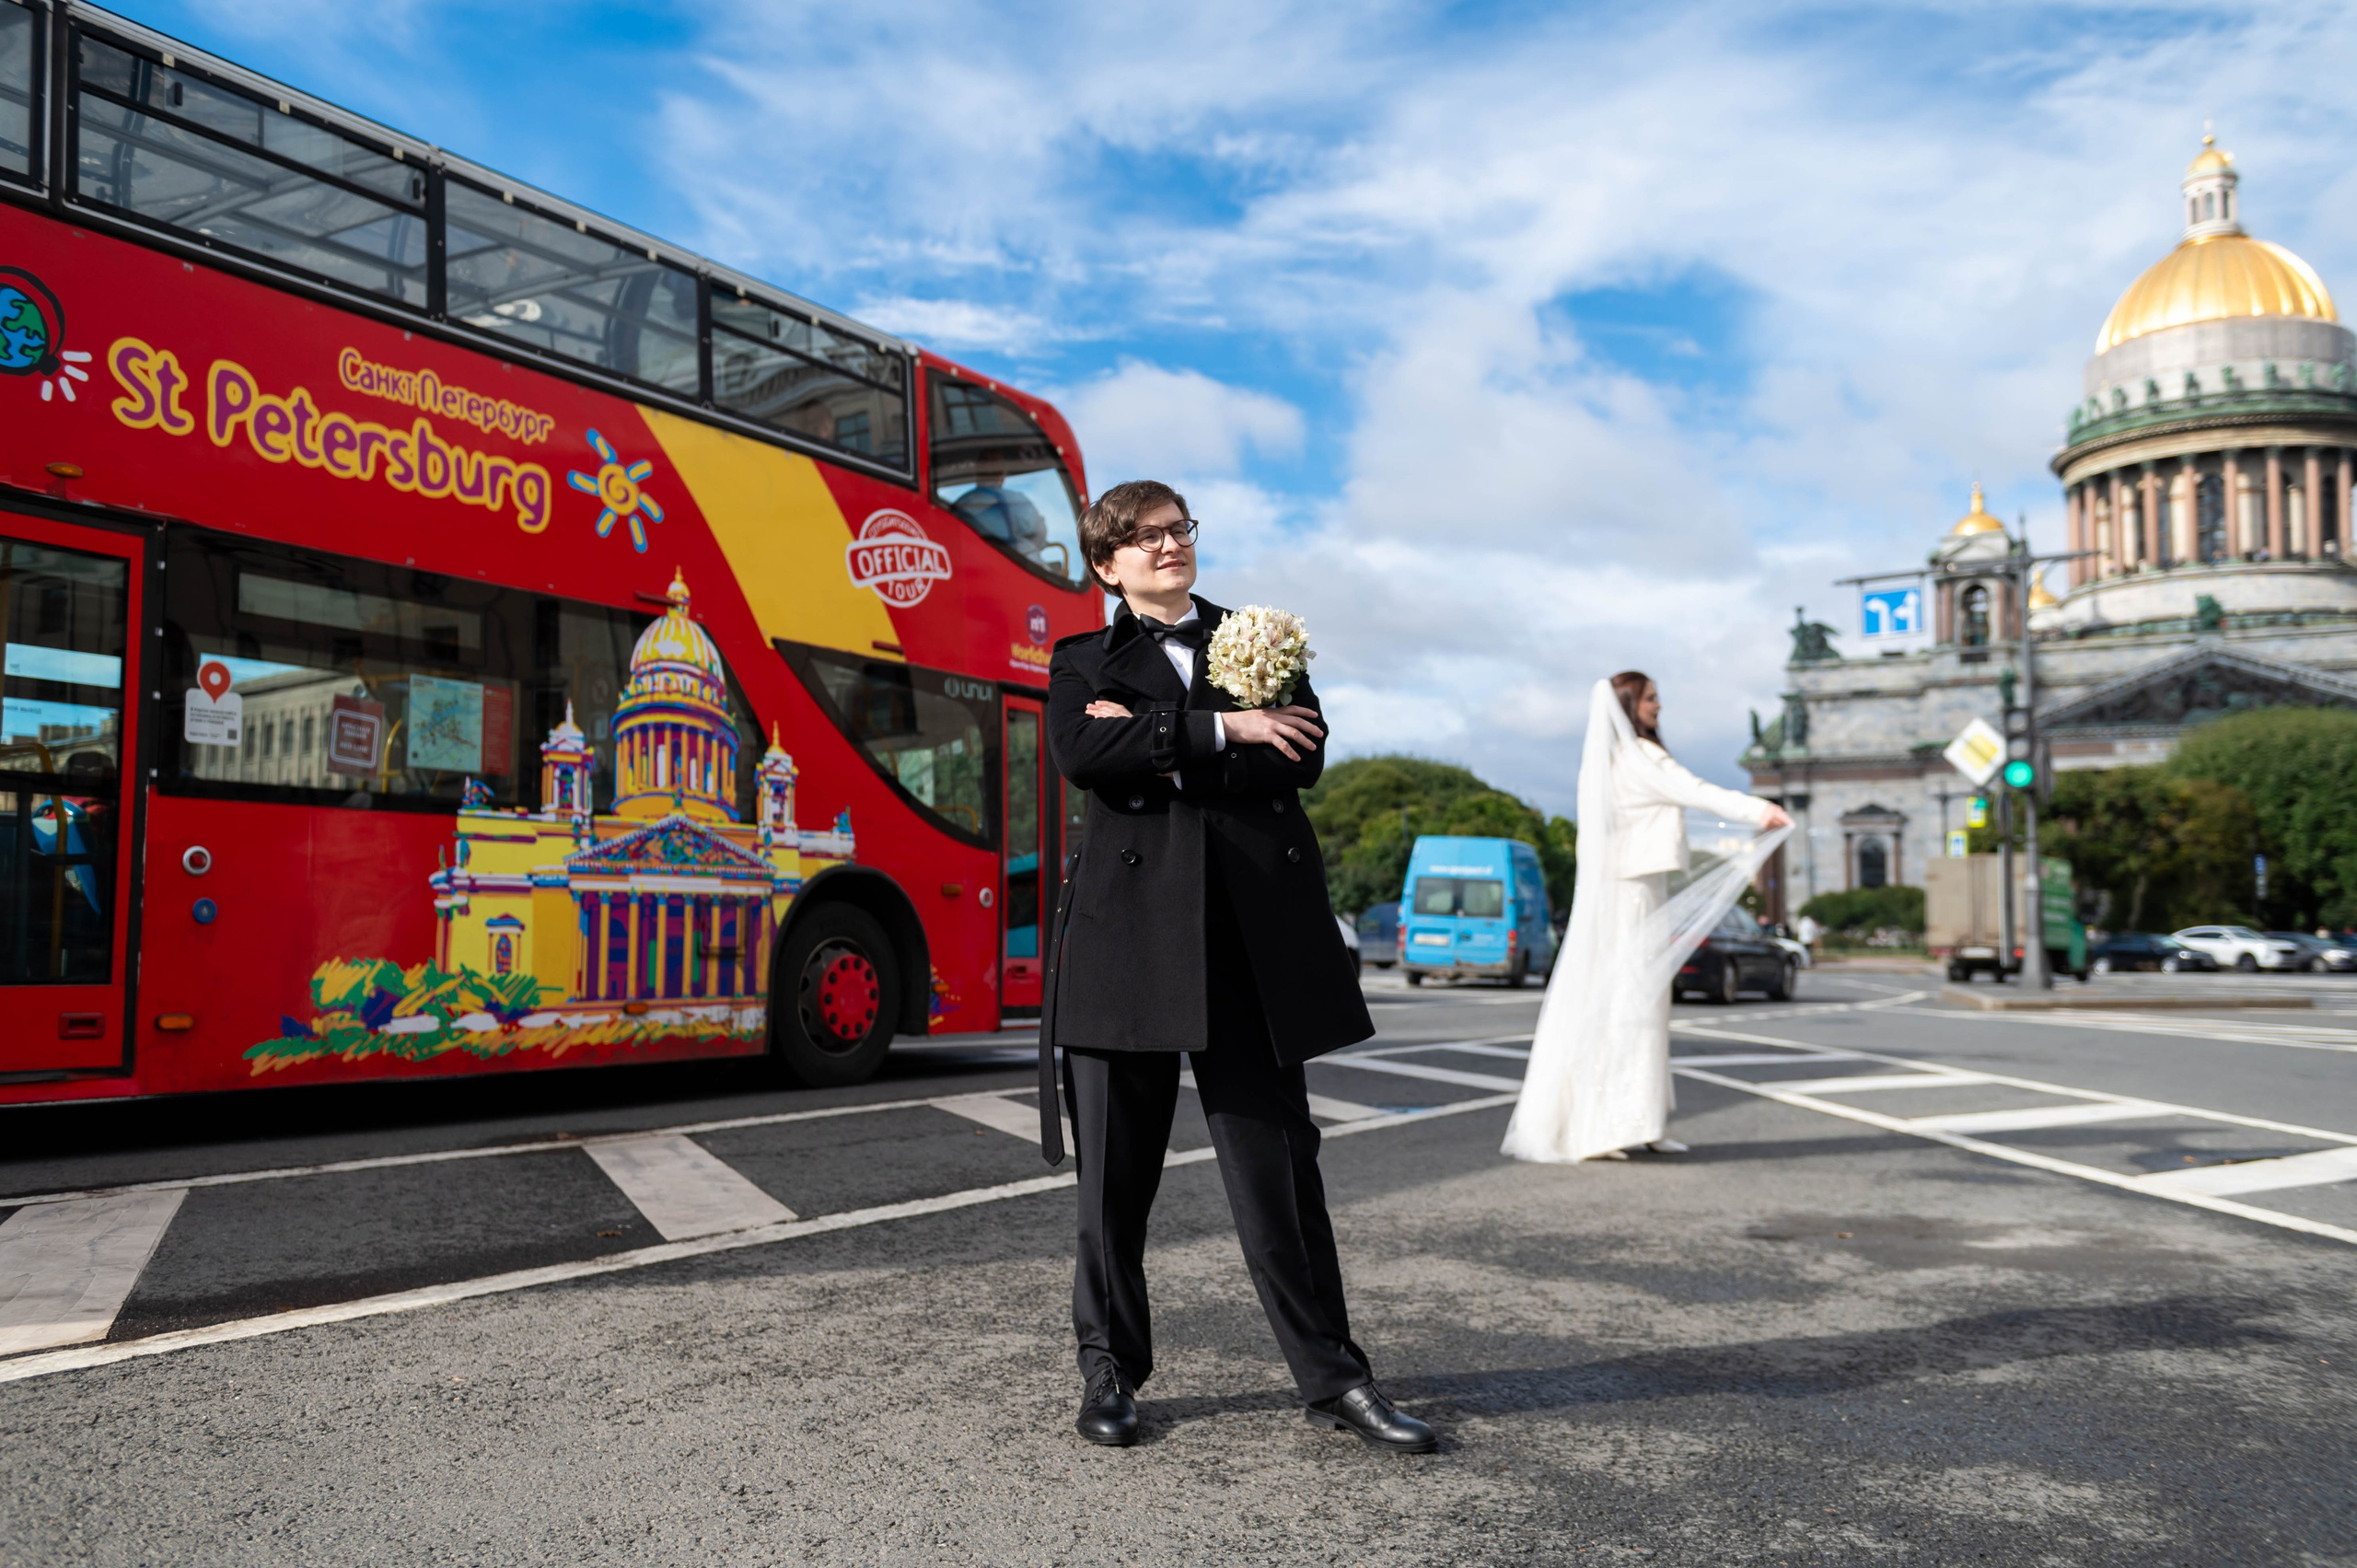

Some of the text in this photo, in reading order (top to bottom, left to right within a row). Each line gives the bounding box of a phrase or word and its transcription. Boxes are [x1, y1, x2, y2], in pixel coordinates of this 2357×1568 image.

[108, 337, 552, 533] St Petersburg
[857, 546, 945, 577] OFFICIAL
[888, 578, 926, 600] TOUR
